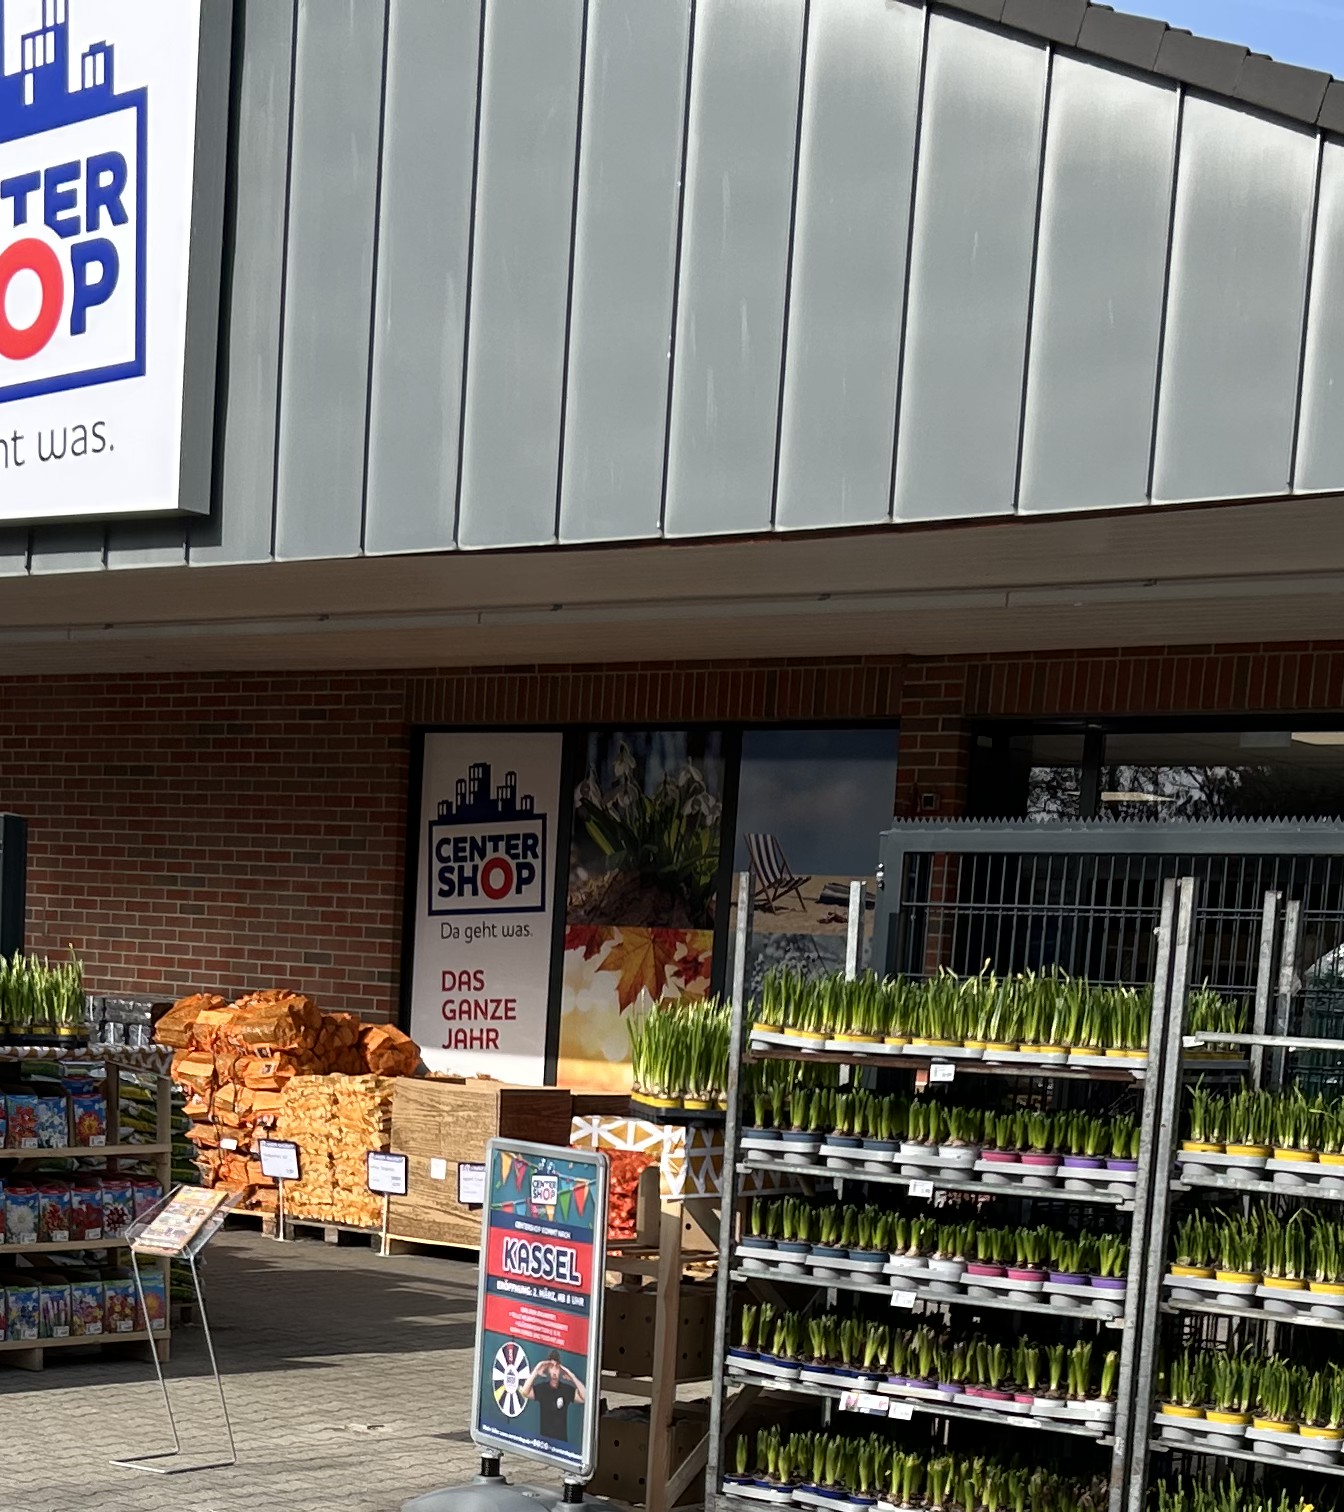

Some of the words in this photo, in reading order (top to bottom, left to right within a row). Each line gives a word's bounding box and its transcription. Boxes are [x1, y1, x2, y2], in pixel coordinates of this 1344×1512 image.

[37, 421, 115, 463] was.
[435, 832, 539, 864] CENTER
[437, 857, 536, 900] SHOP
[440, 922, 460, 940] Da
[464, 922, 497, 943] geht
[501, 922, 533, 938] was.
[441, 970, 485, 993] DAS
[441, 998, 517, 1021] GANZE
[442, 1027, 499, 1050] JAHR
[503, 1238, 582, 1285] KASSEL
